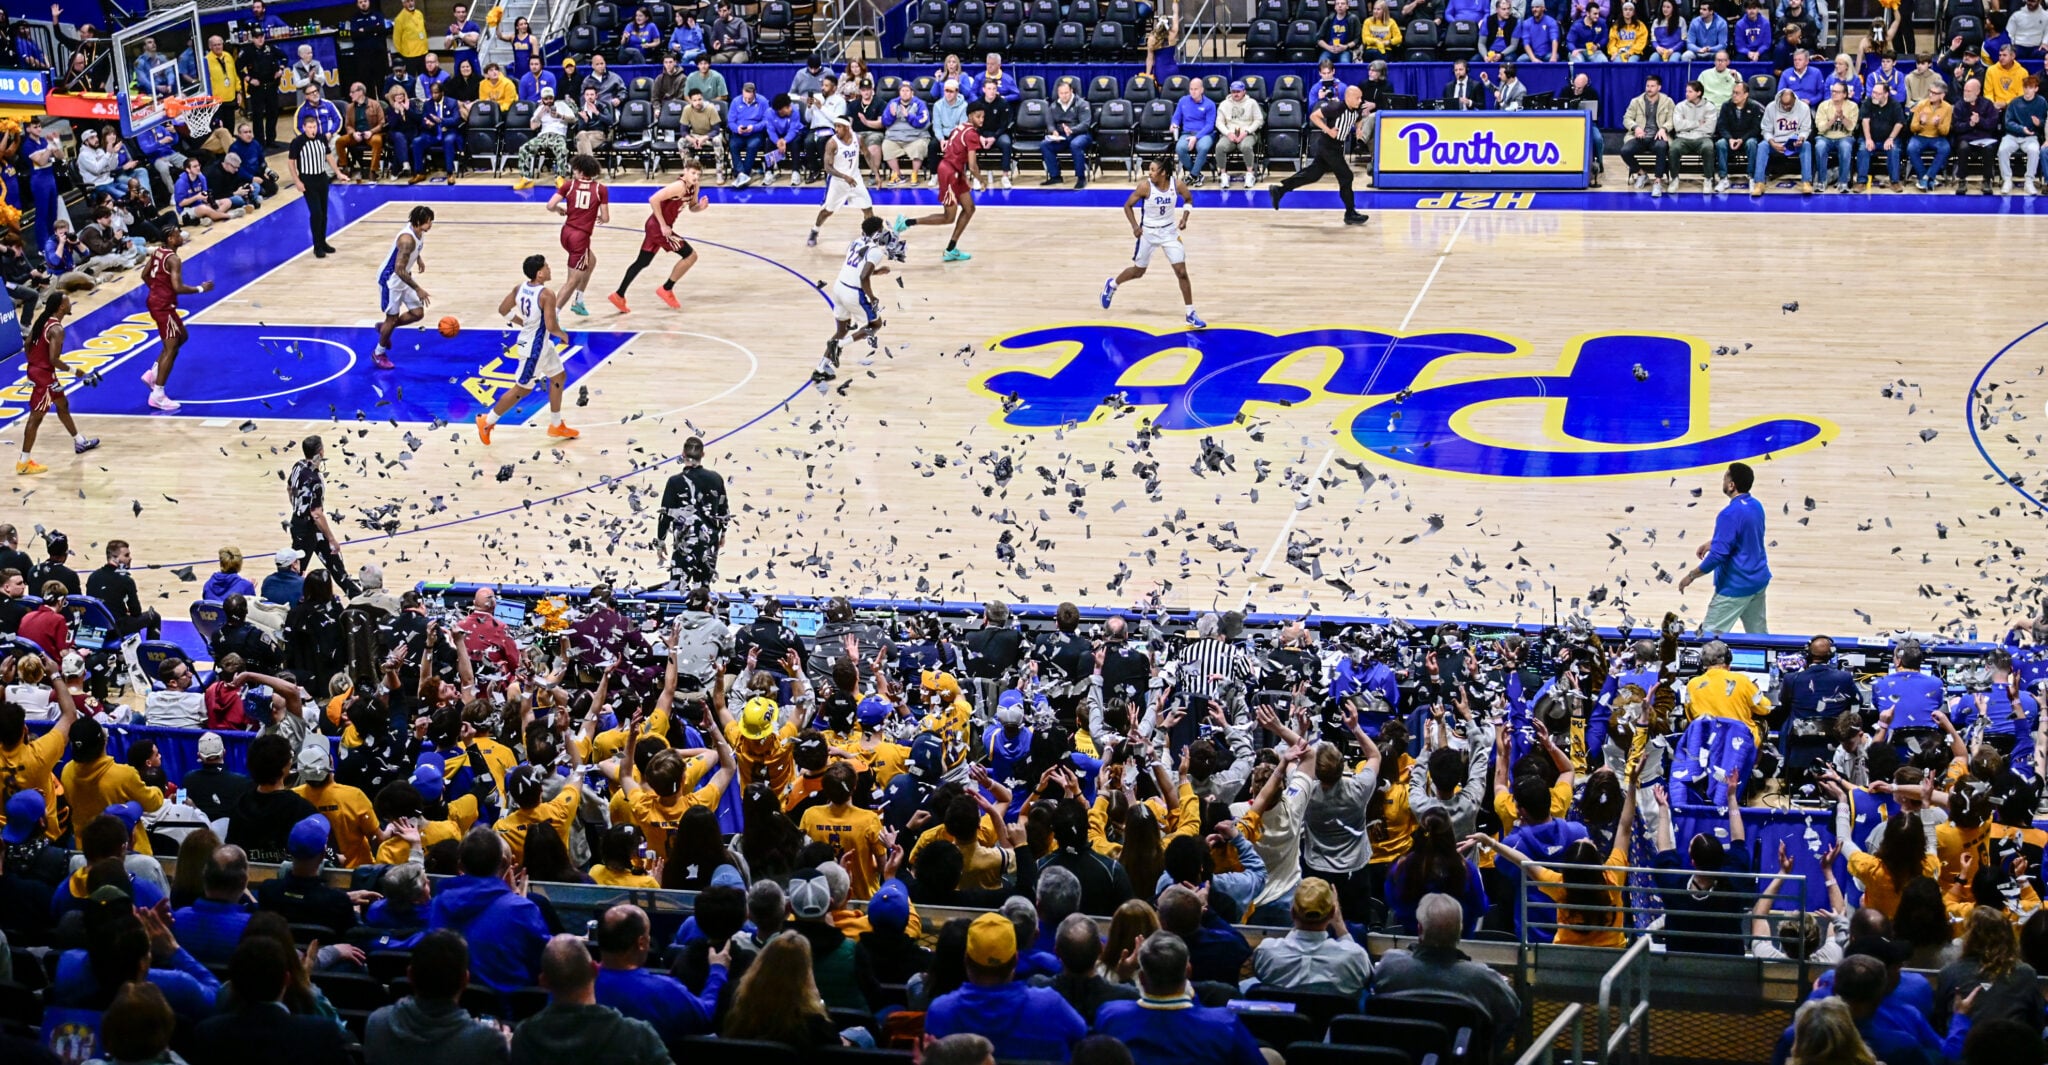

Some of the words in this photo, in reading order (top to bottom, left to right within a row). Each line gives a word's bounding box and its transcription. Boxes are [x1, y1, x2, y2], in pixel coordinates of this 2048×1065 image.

[1618, 29, 1636, 41] Pitt
[1776, 118, 1799, 131] Pitt
[1397, 121, 1561, 166] Panthers
[843, 150, 857, 159] Pitt
[575, 190, 592, 214] 10
[1154, 197, 1171, 205] Pitt
[1159, 206, 1166, 216] 8
[520, 296, 532, 318] 13
[968, 321, 1841, 482] Pitt
